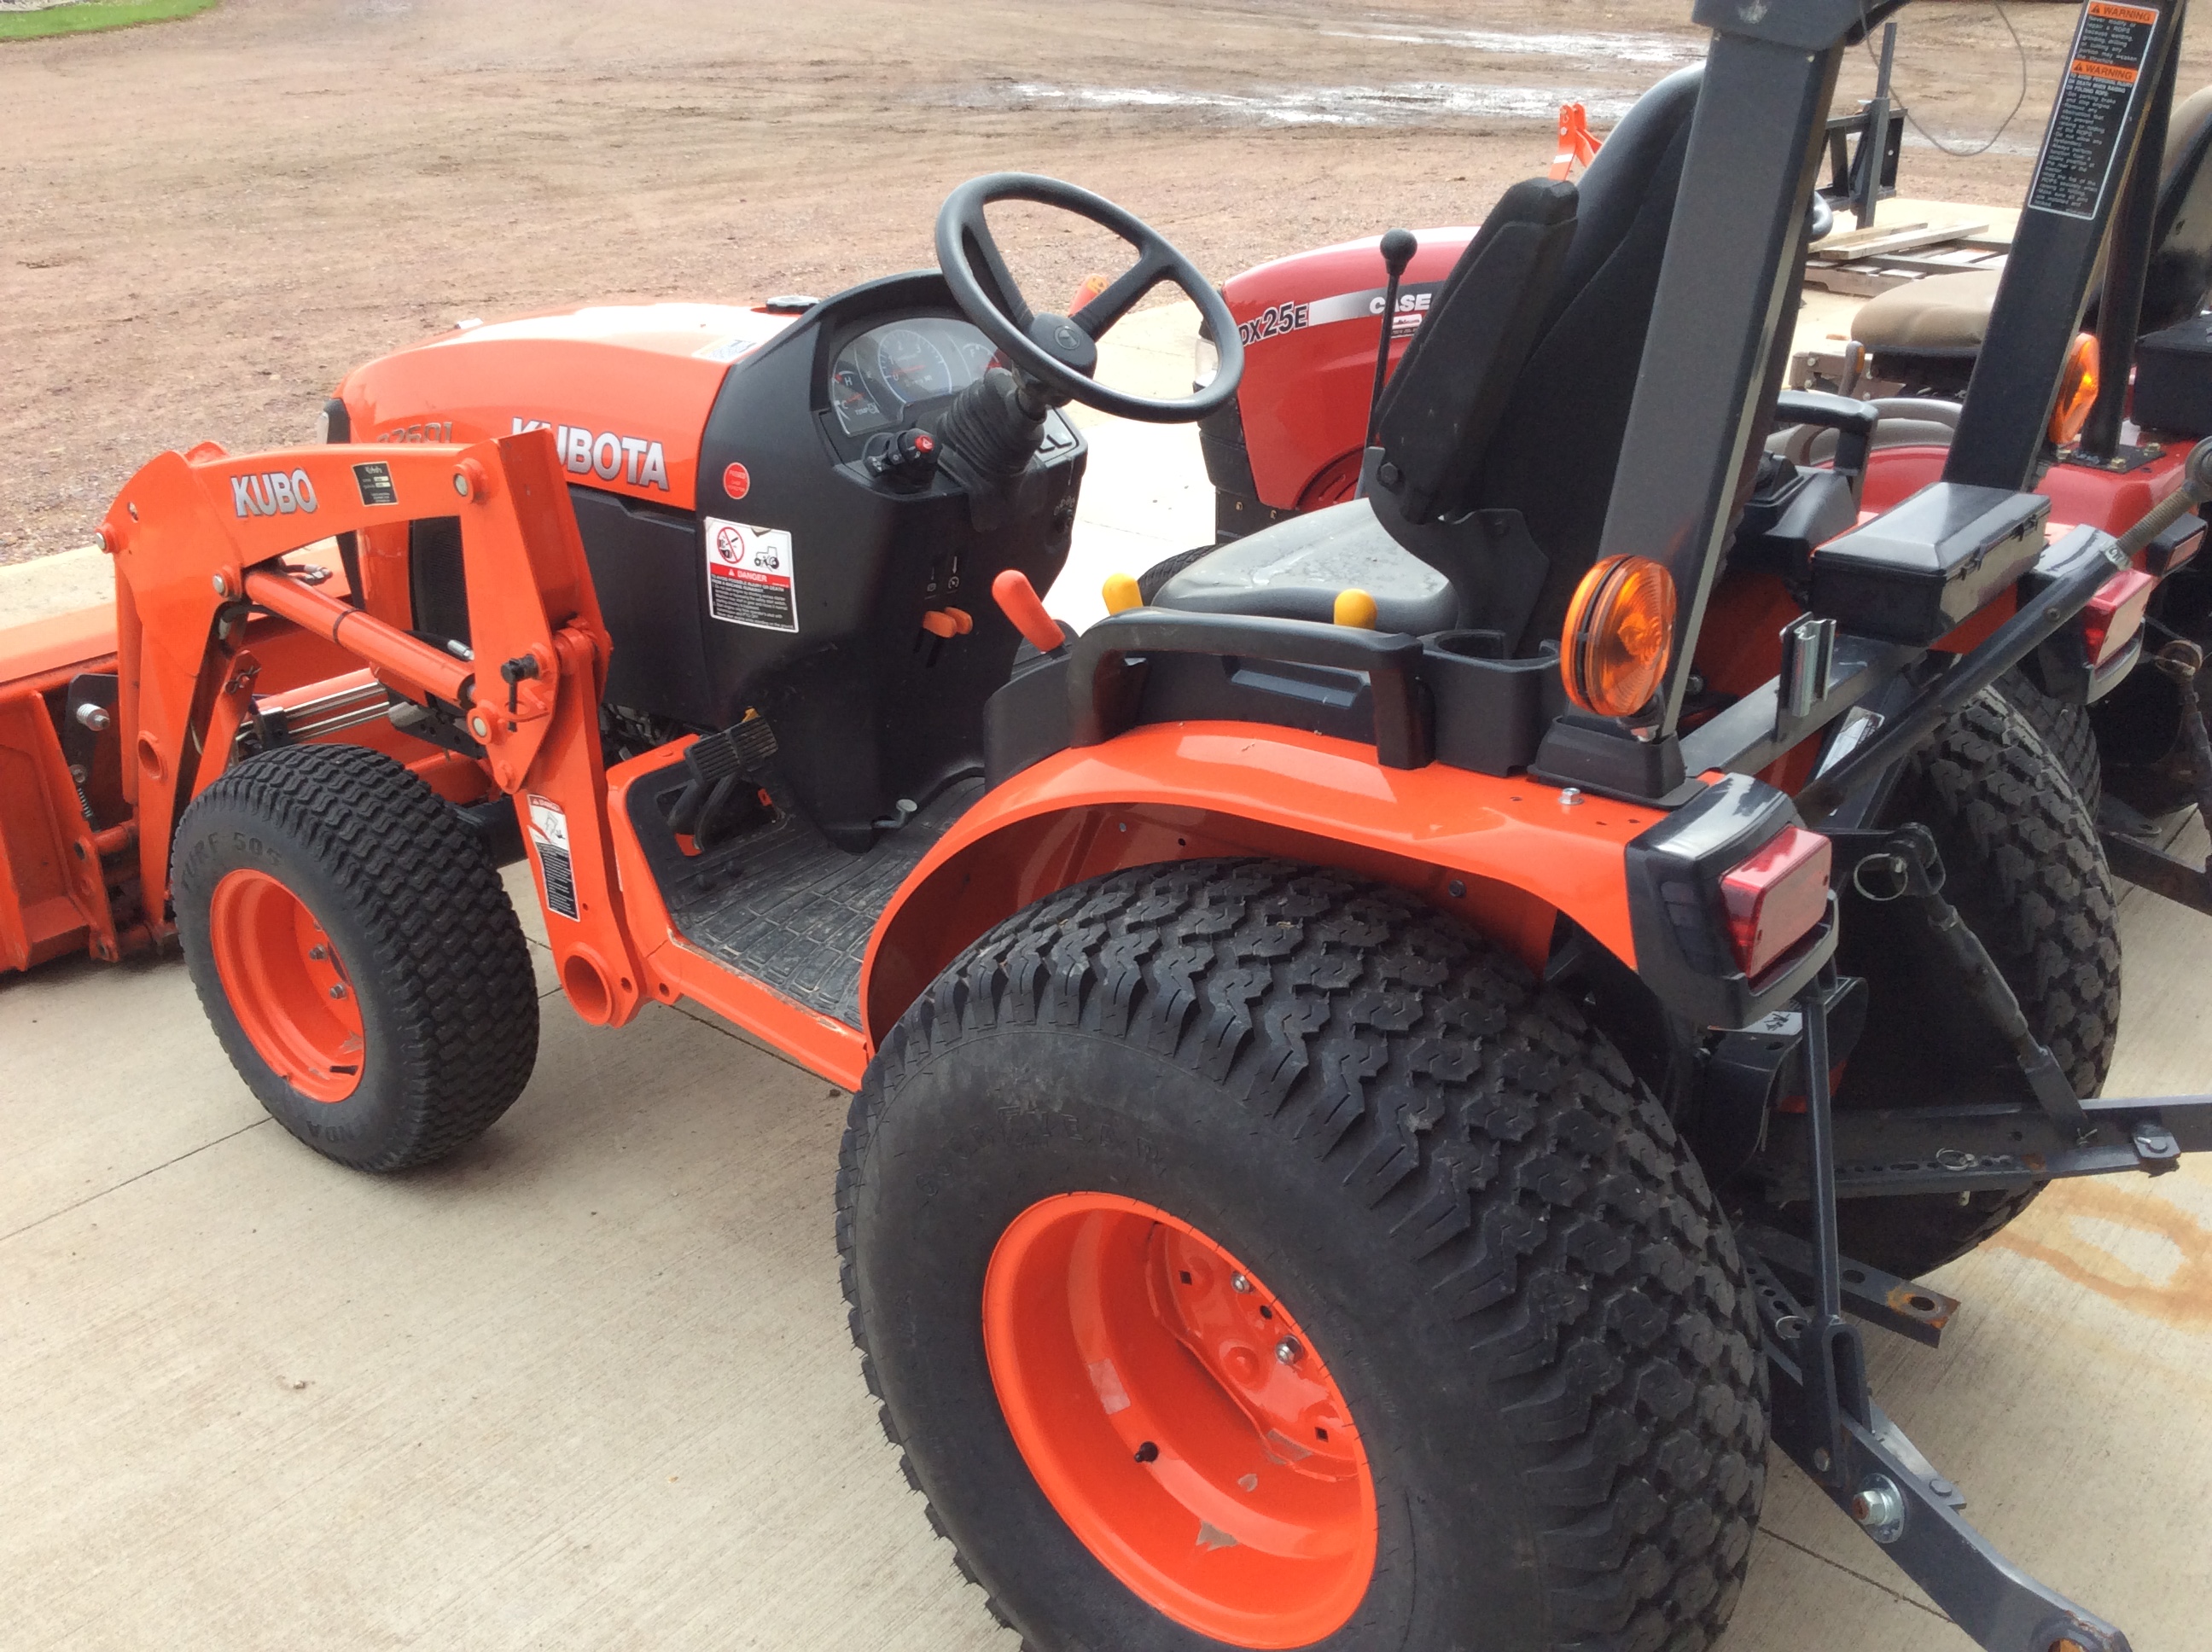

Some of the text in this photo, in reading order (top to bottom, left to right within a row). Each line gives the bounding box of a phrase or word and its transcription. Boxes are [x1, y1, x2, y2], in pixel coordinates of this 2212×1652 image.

[2104, 6, 2151, 20] WARNING
[2086, 64, 2132, 79] WARNING
[1369, 294, 1432, 315] CSE
[1238, 301, 1308, 346] DX25E
[844, 376, 853, 387] H
[230, 467, 319, 518] KUBO
[737, 570, 767, 582] DANGER
